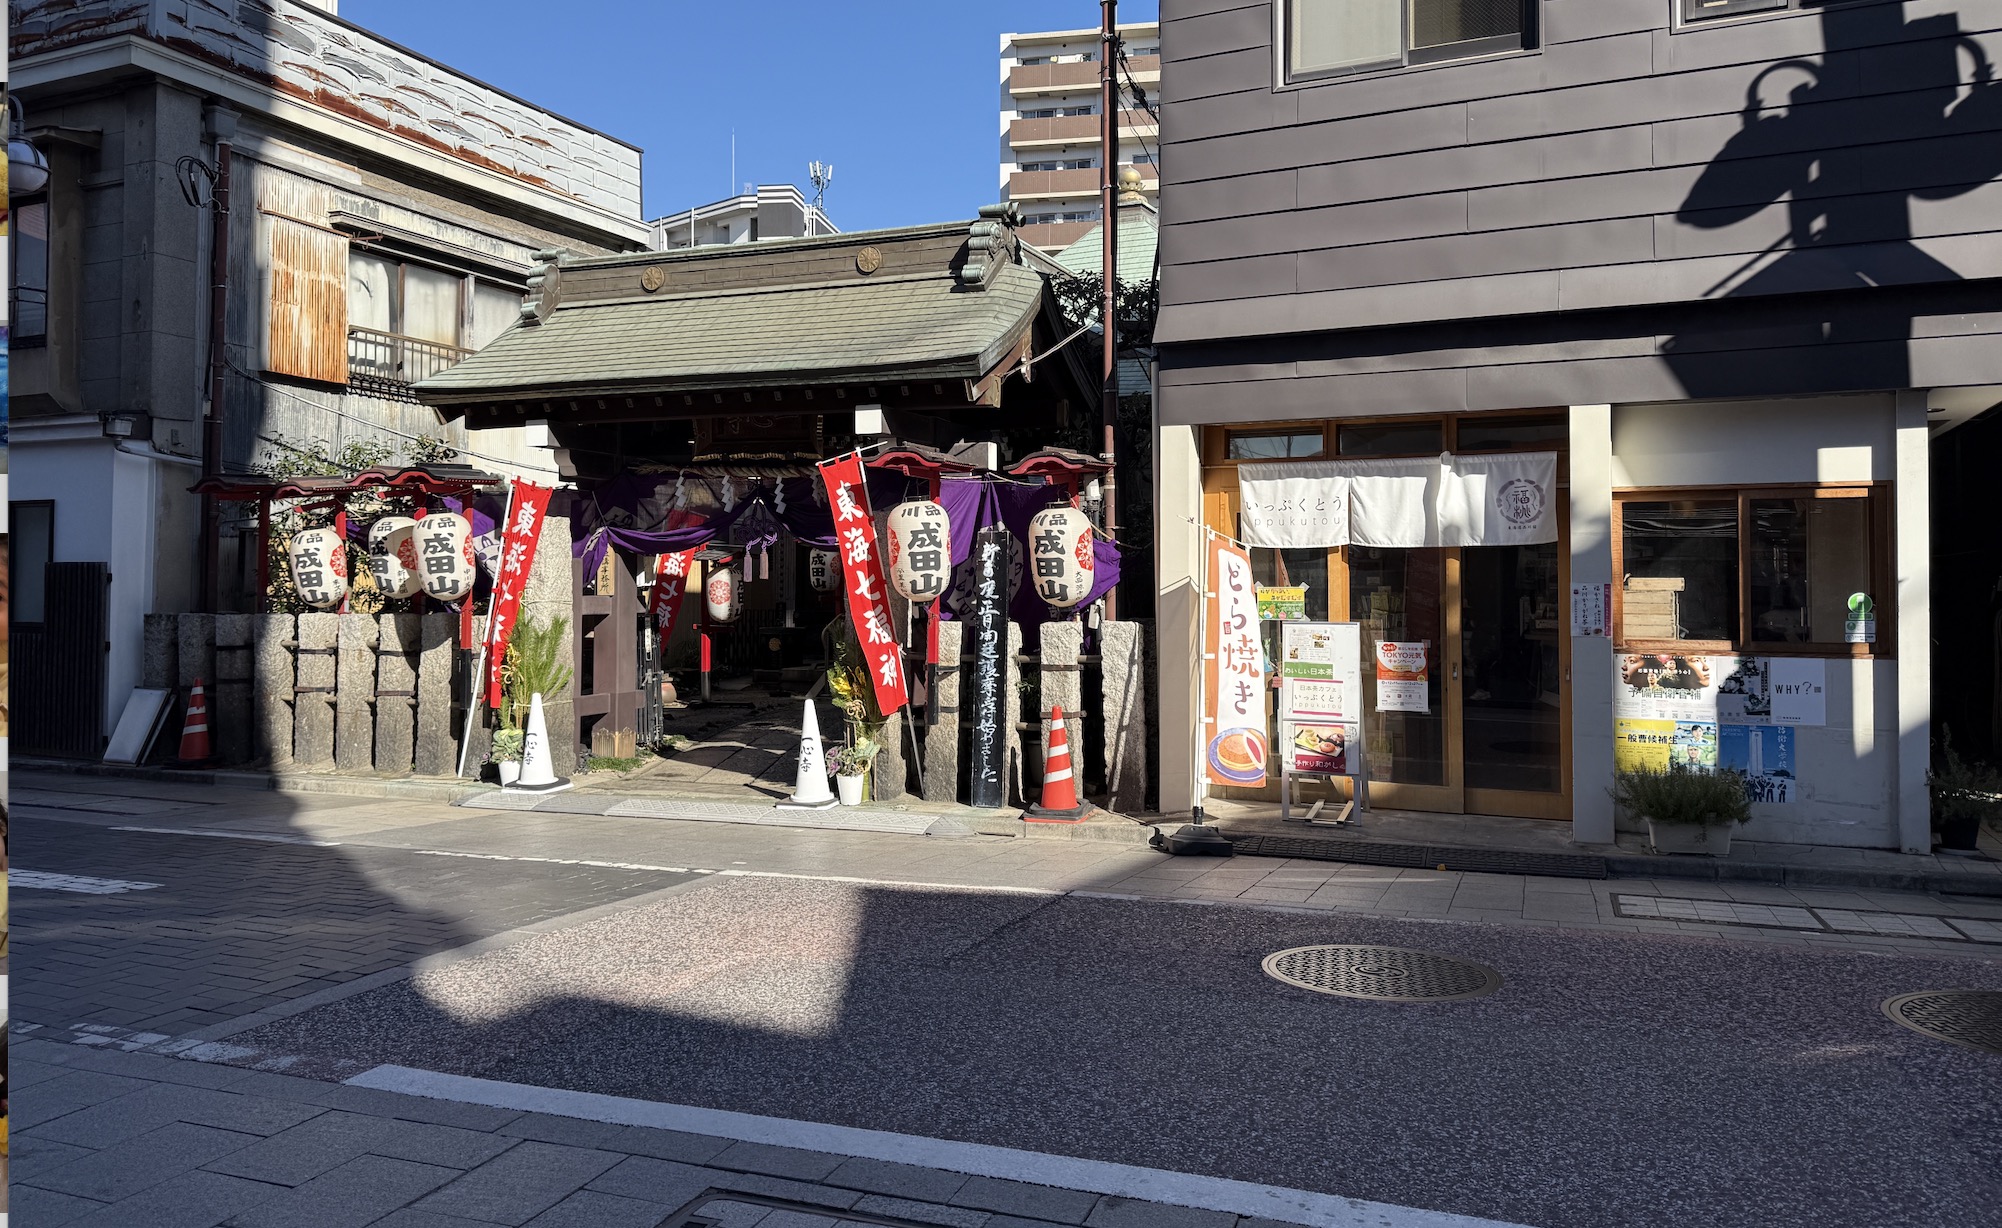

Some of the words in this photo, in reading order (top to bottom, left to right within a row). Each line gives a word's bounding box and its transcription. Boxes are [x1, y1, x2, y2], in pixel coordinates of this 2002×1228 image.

[1246, 496, 1342, 512] いっぷくとう
[1254, 516, 1341, 528] ppukutou
[370, 535, 395, 594] 成田山
[422, 533, 460, 595] 成田山
[811, 554, 827, 589] 成田山
[908, 522, 943, 595] 成田山
[1035, 530, 1068, 602] 成田山
[295, 548, 330, 604] 成田山
[836, 480, 897, 688] 東海七福神
[1223, 561, 1260, 715] どら焼き
[1285, 667, 1333, 676] おいしい日本茶
[1300, 684, 1337, 692] 日本茶カフェ
[1775, 681, 1812, 695] WHY?
[1294, 694, 1343, 703] いっぷくとう
[1628, 687, 1702, 700] 予備自衛官補
[525, 732, 538, 765] 一心寺
[800, 737, 814, 772] 一心寺
[1617, 733, 1679, 745] 一般曹候補生
[1296, 760, 1339, 770] 手作り和がし
